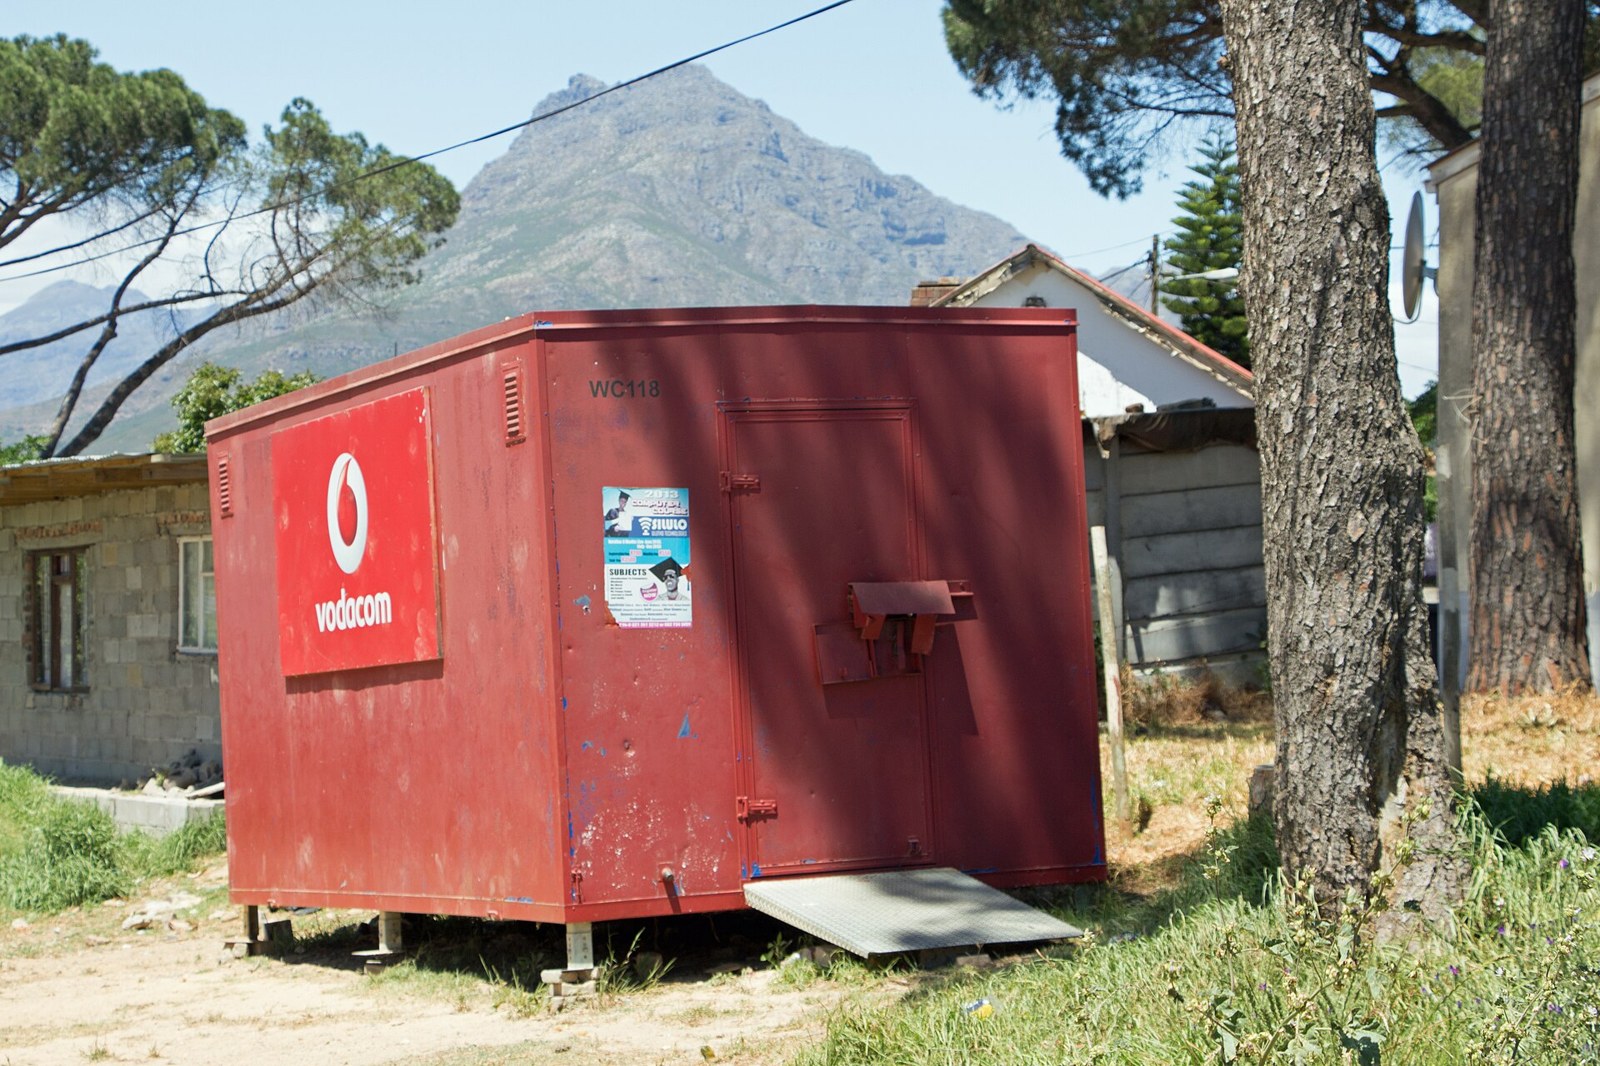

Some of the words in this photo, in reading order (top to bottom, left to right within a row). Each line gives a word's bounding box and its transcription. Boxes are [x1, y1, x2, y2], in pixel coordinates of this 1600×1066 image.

[589, 380, 660, 398] WC118
[644, 489, 680, 499] 2013
[632, 500, 681, 509] COMPUTER
[653, 508, 688, 516] COURSE
[651, 518, 688, 531] SILULO
[609, 568, 647, 576] SUBJECTS
[315, 587, 392, 633] vodacom
